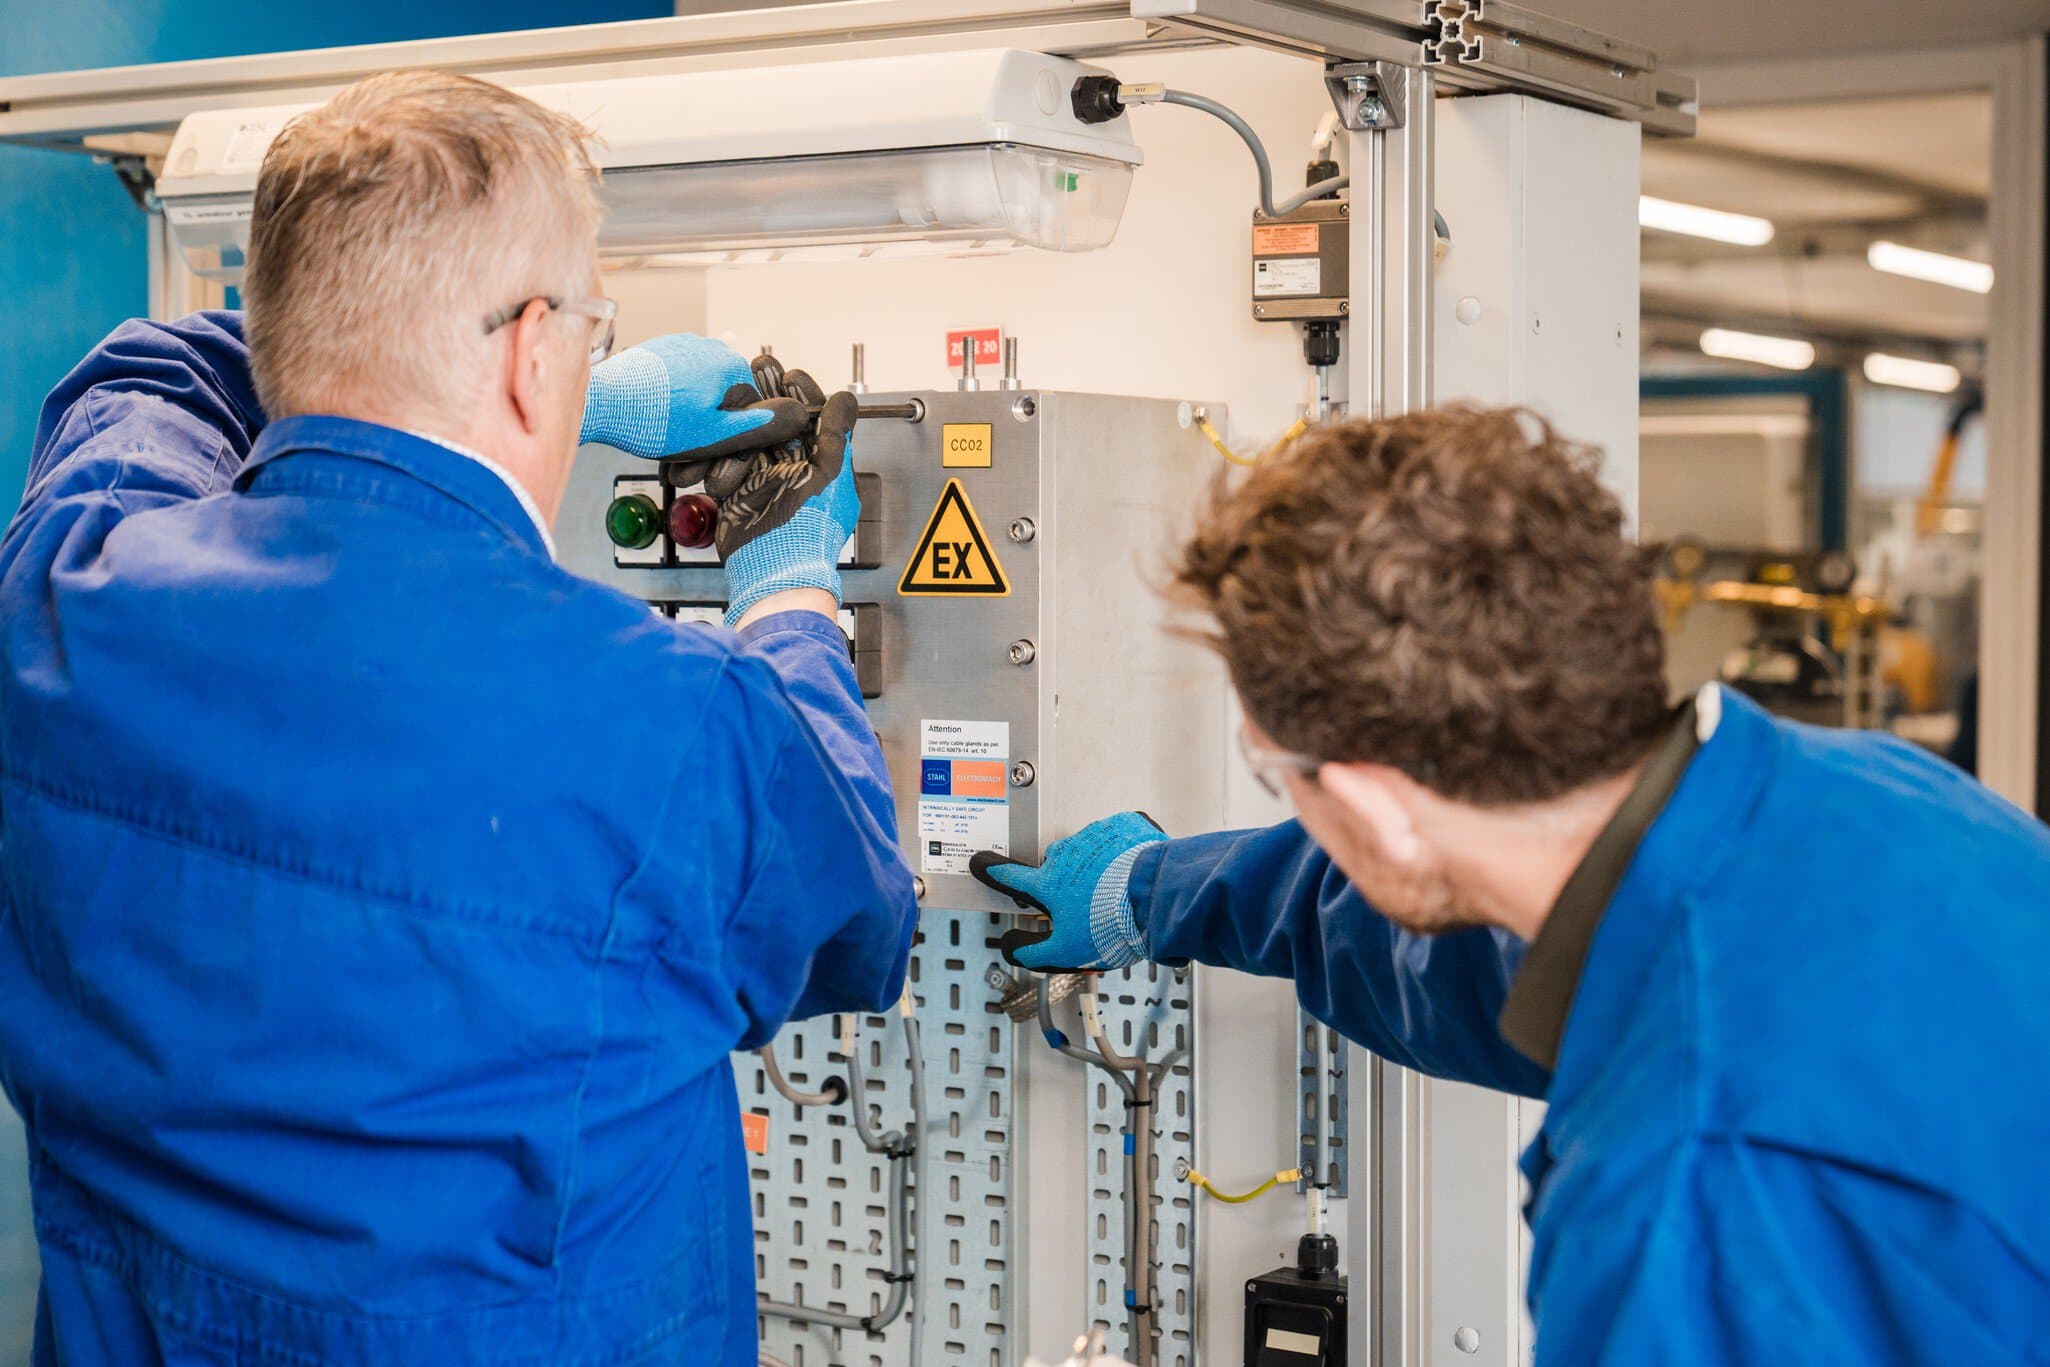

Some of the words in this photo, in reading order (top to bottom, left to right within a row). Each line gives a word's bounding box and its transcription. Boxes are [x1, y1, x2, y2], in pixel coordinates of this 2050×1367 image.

[932, 542, 973, 579] EX
[928, 725, 962, 733] Attention
[927, 773, 946, 781] STAHL
